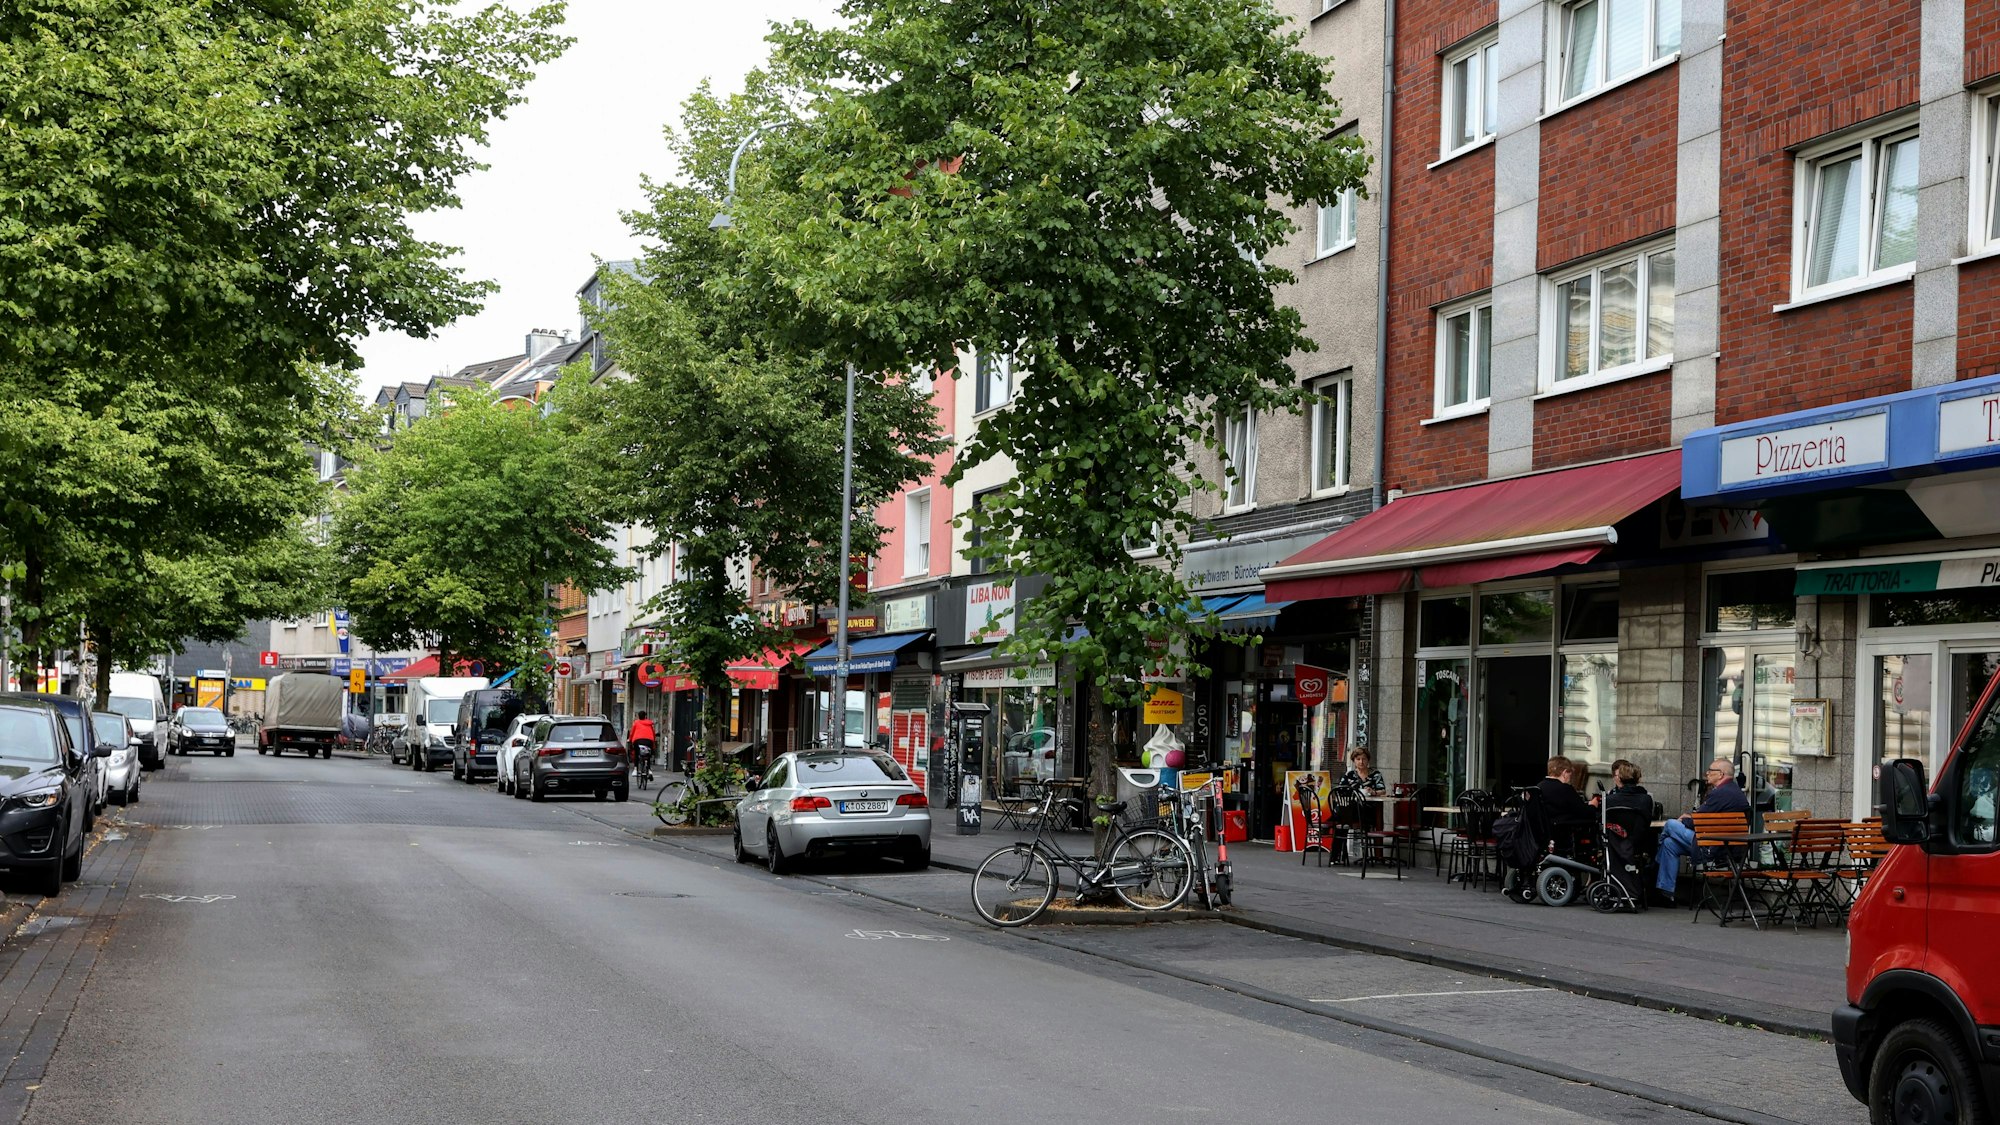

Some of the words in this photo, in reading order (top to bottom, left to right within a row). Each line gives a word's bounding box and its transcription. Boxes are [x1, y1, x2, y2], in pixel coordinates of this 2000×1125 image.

[1983, 397, 2000, 442] T
[1756, 427, 1846, 475] Pizzeria
[1824, 571, 1899, 591] TRATTORIA
[1435, 670, 1460, 685] TOSCANA
[867, 801, 886, 810] 2887
